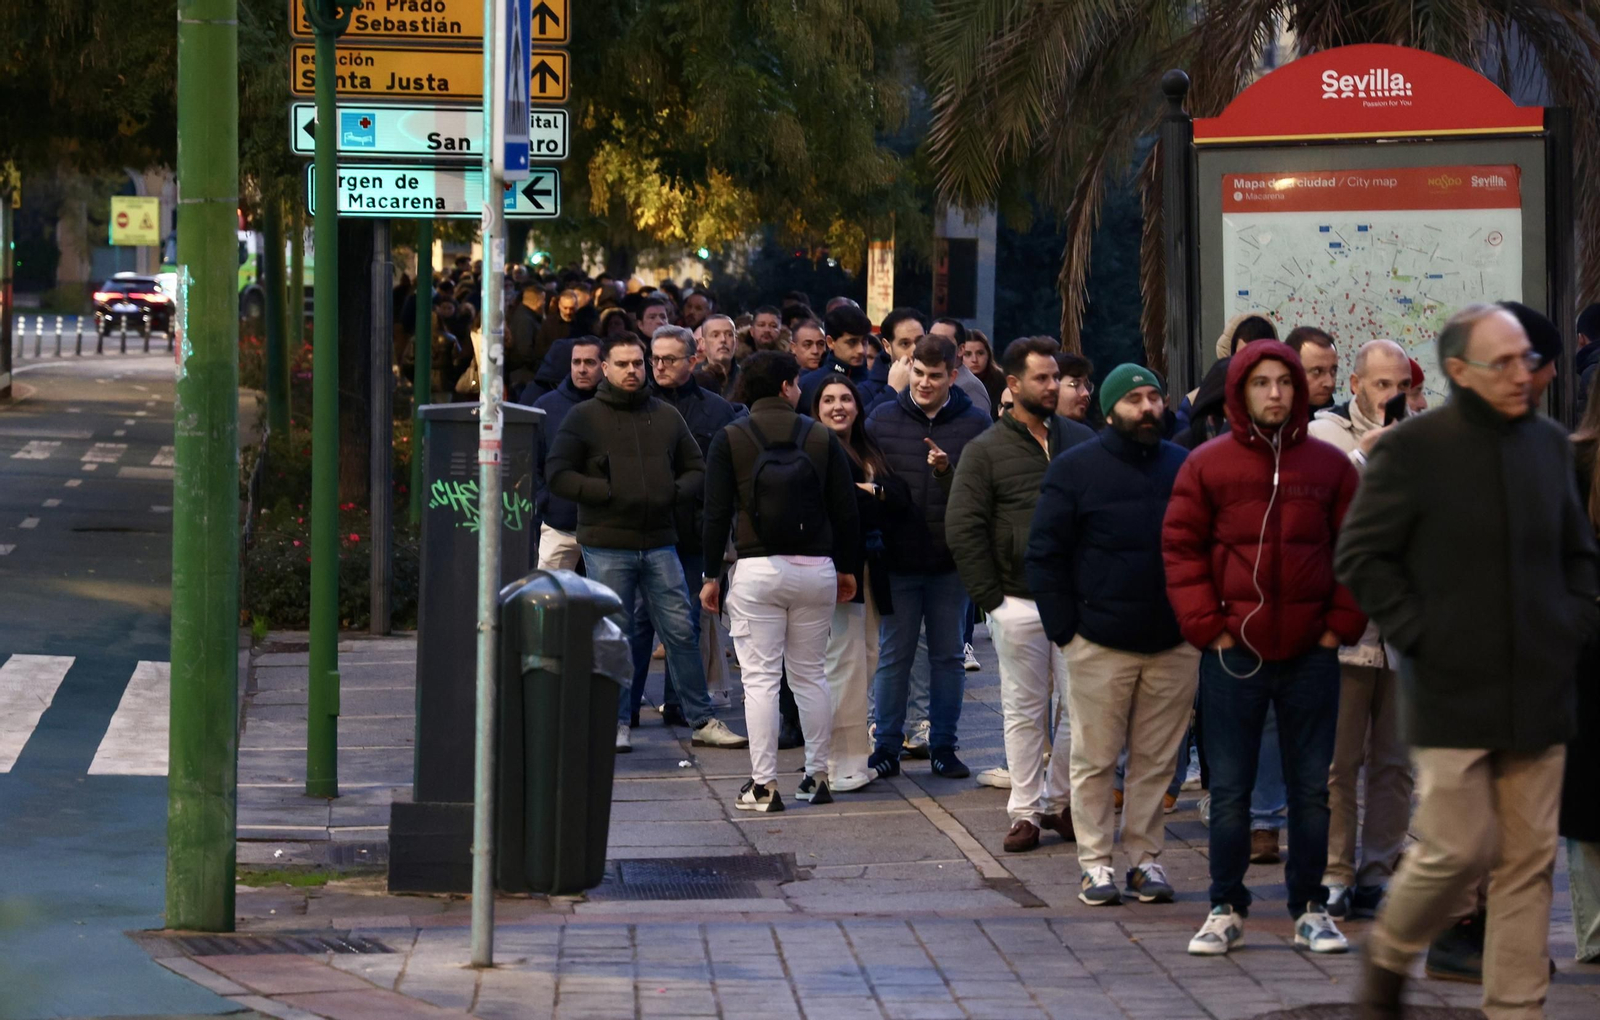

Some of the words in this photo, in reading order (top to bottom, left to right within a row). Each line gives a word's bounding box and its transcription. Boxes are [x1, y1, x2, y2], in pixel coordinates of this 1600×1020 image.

[387, 0, 446, 13] Prado
[355, 15, 462, 34] Sebastián
[301, 52, 375, 67] esción
[302, 69, 371, 89] Snta
[386, 72, 449, 91] Justa
[427, 132, 471, 151] San
[338, 175, 383, 191] rgen
[395, 174, 418, 189] de
[1233, 178, 1265, 190] Mapa
[1296, 177, 1336, 188] ciudad
[1347, 176, 1370, 189] City
[1372, 177, 1398, 188] map
[348, 193, 446, 210] Macarena
[1245, 192, 1285, 201] Macarena
